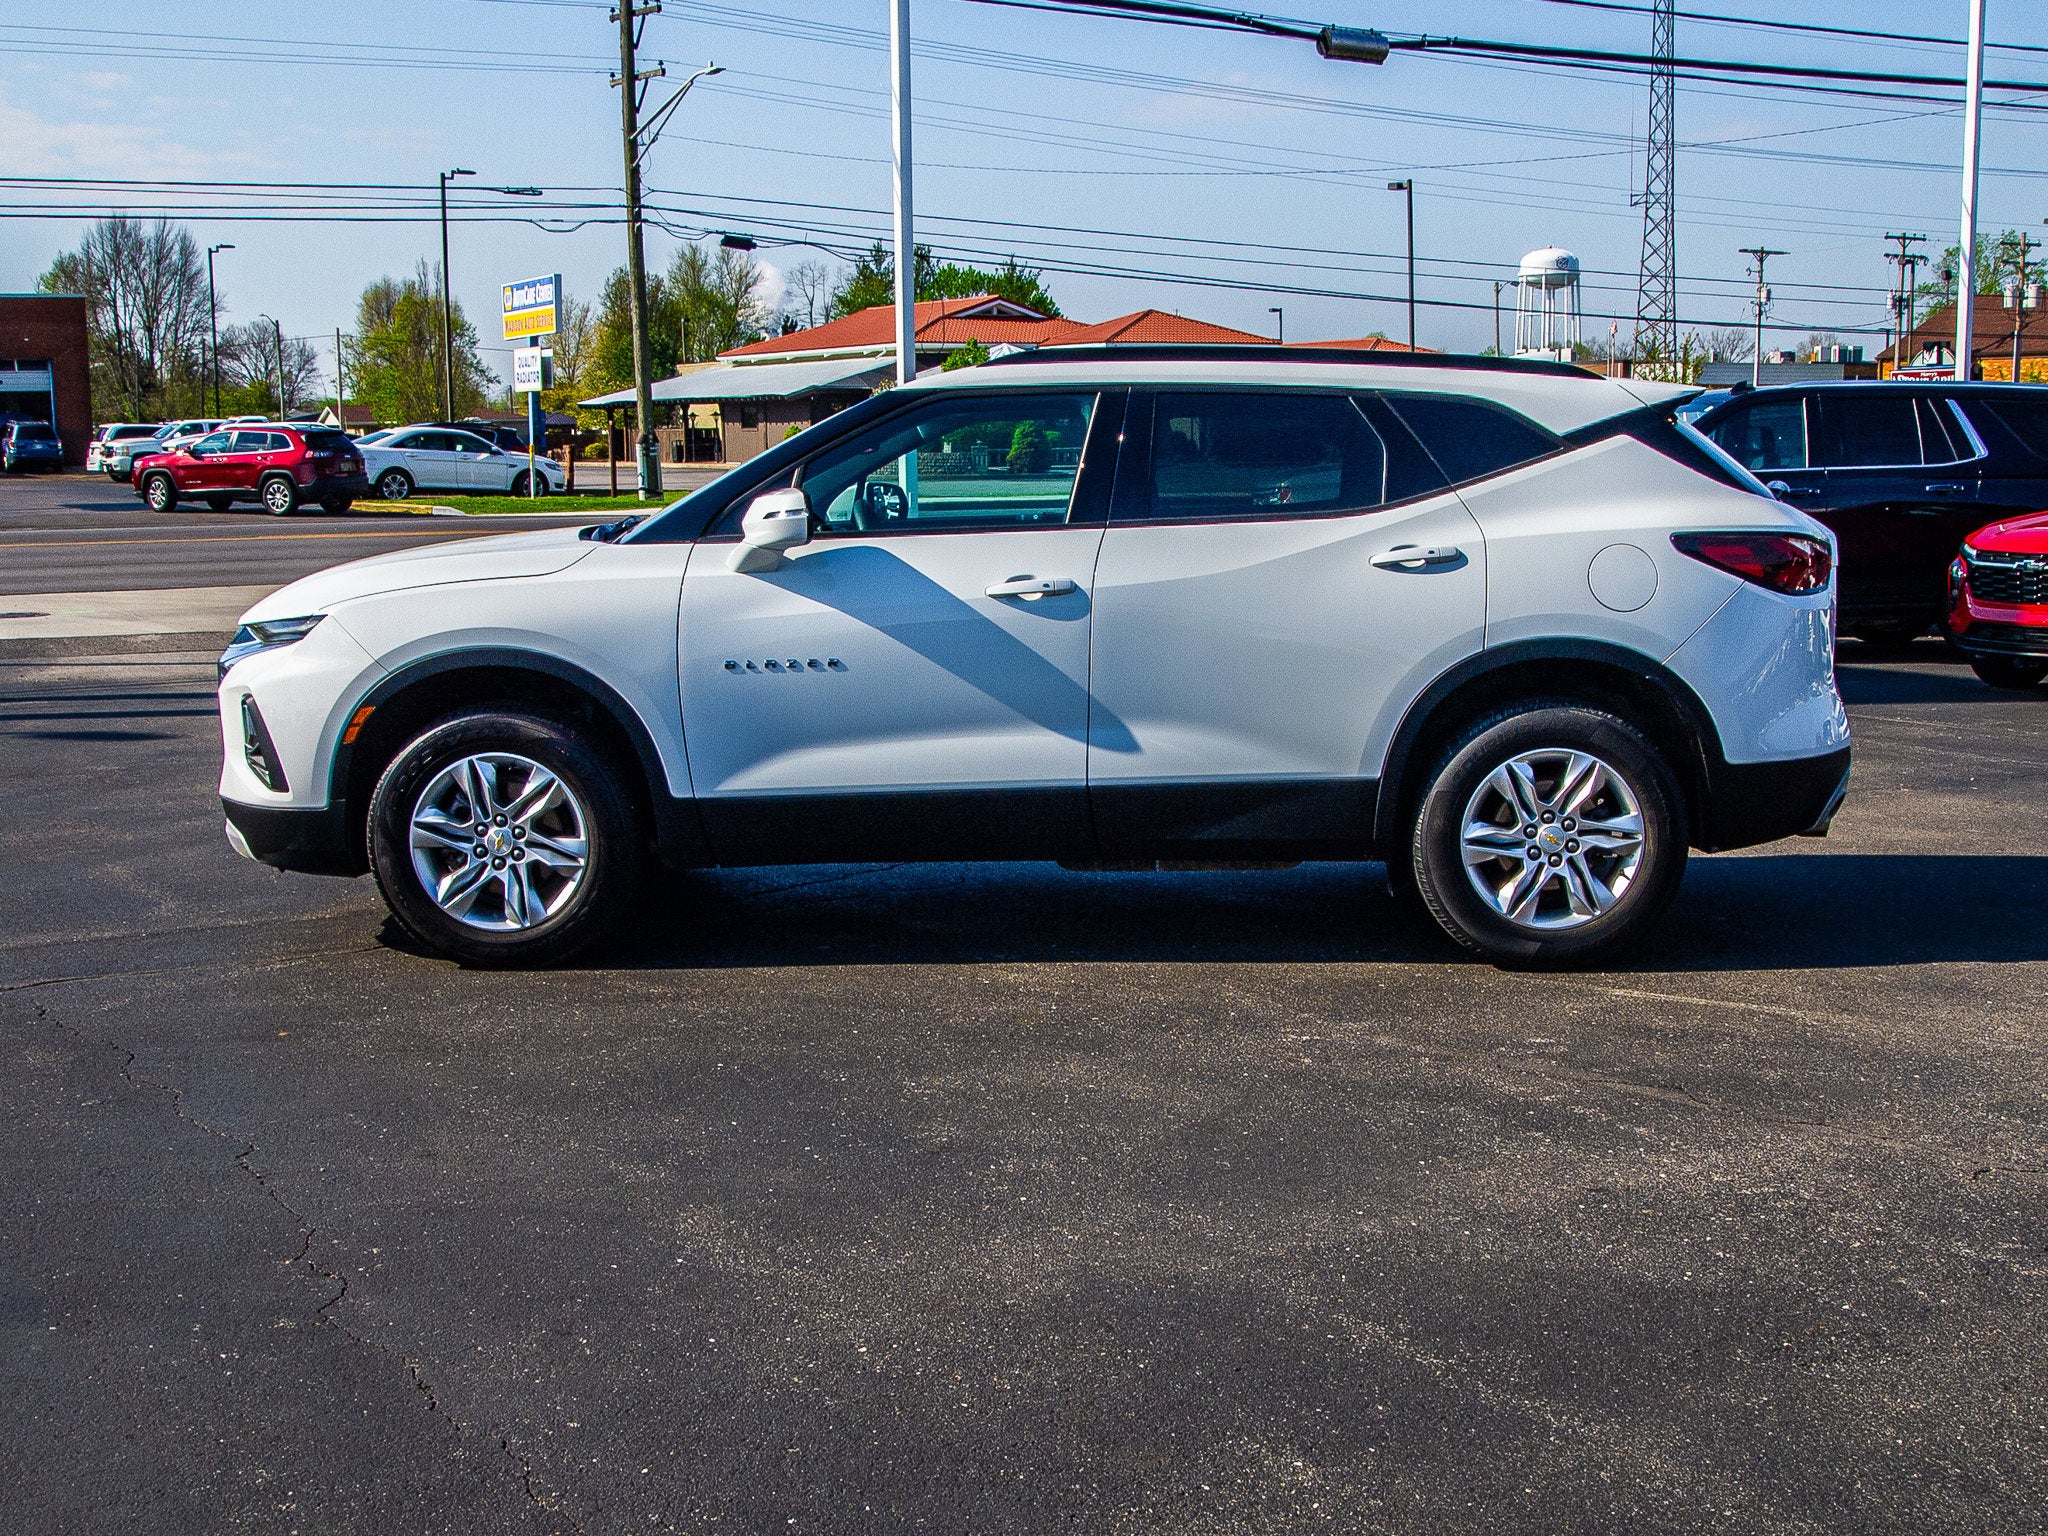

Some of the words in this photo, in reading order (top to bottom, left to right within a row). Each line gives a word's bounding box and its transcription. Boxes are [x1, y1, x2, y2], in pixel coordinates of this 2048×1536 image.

[518, 355, 538, 369] QUALITY
[516, 370, 540, 384] RADIATOR
[724, 657, 839, 670] BLAZER
